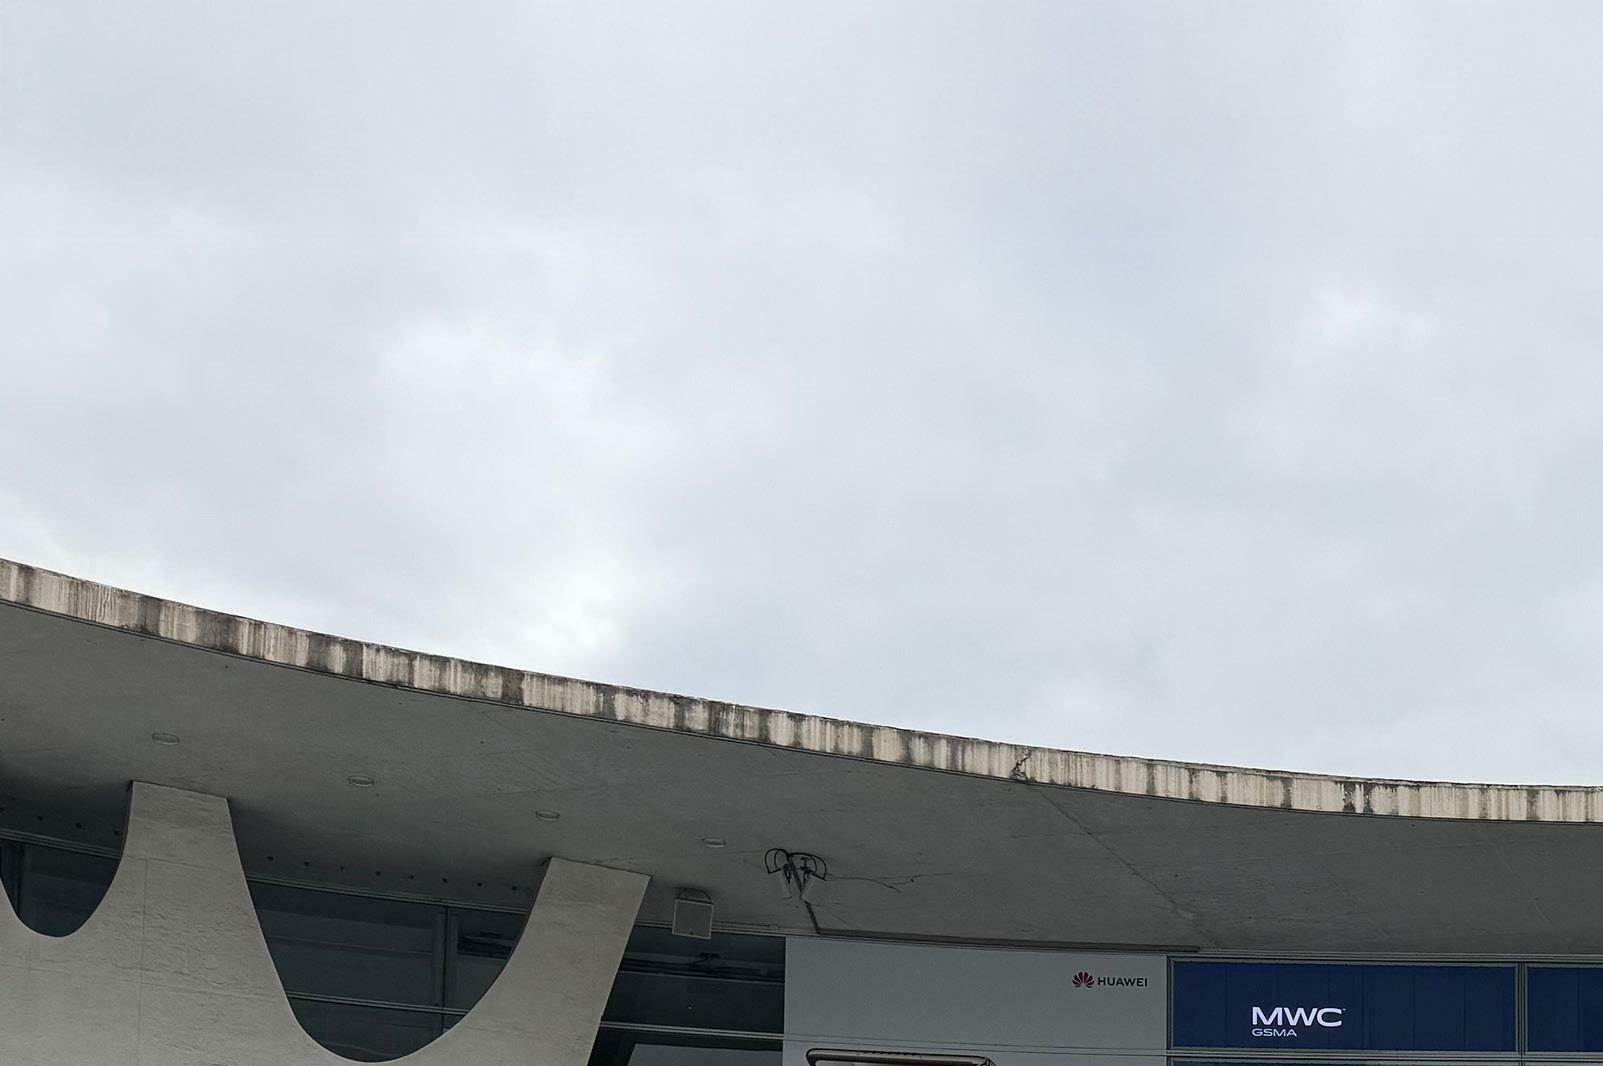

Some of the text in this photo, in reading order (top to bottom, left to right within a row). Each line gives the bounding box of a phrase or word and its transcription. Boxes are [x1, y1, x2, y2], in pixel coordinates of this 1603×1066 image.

[1097, 976, 1148, 987] HUAWEI
[1252, 1006, 1343, 1027] MWC
[1251, 1028, 1298, 1037] GSMA
